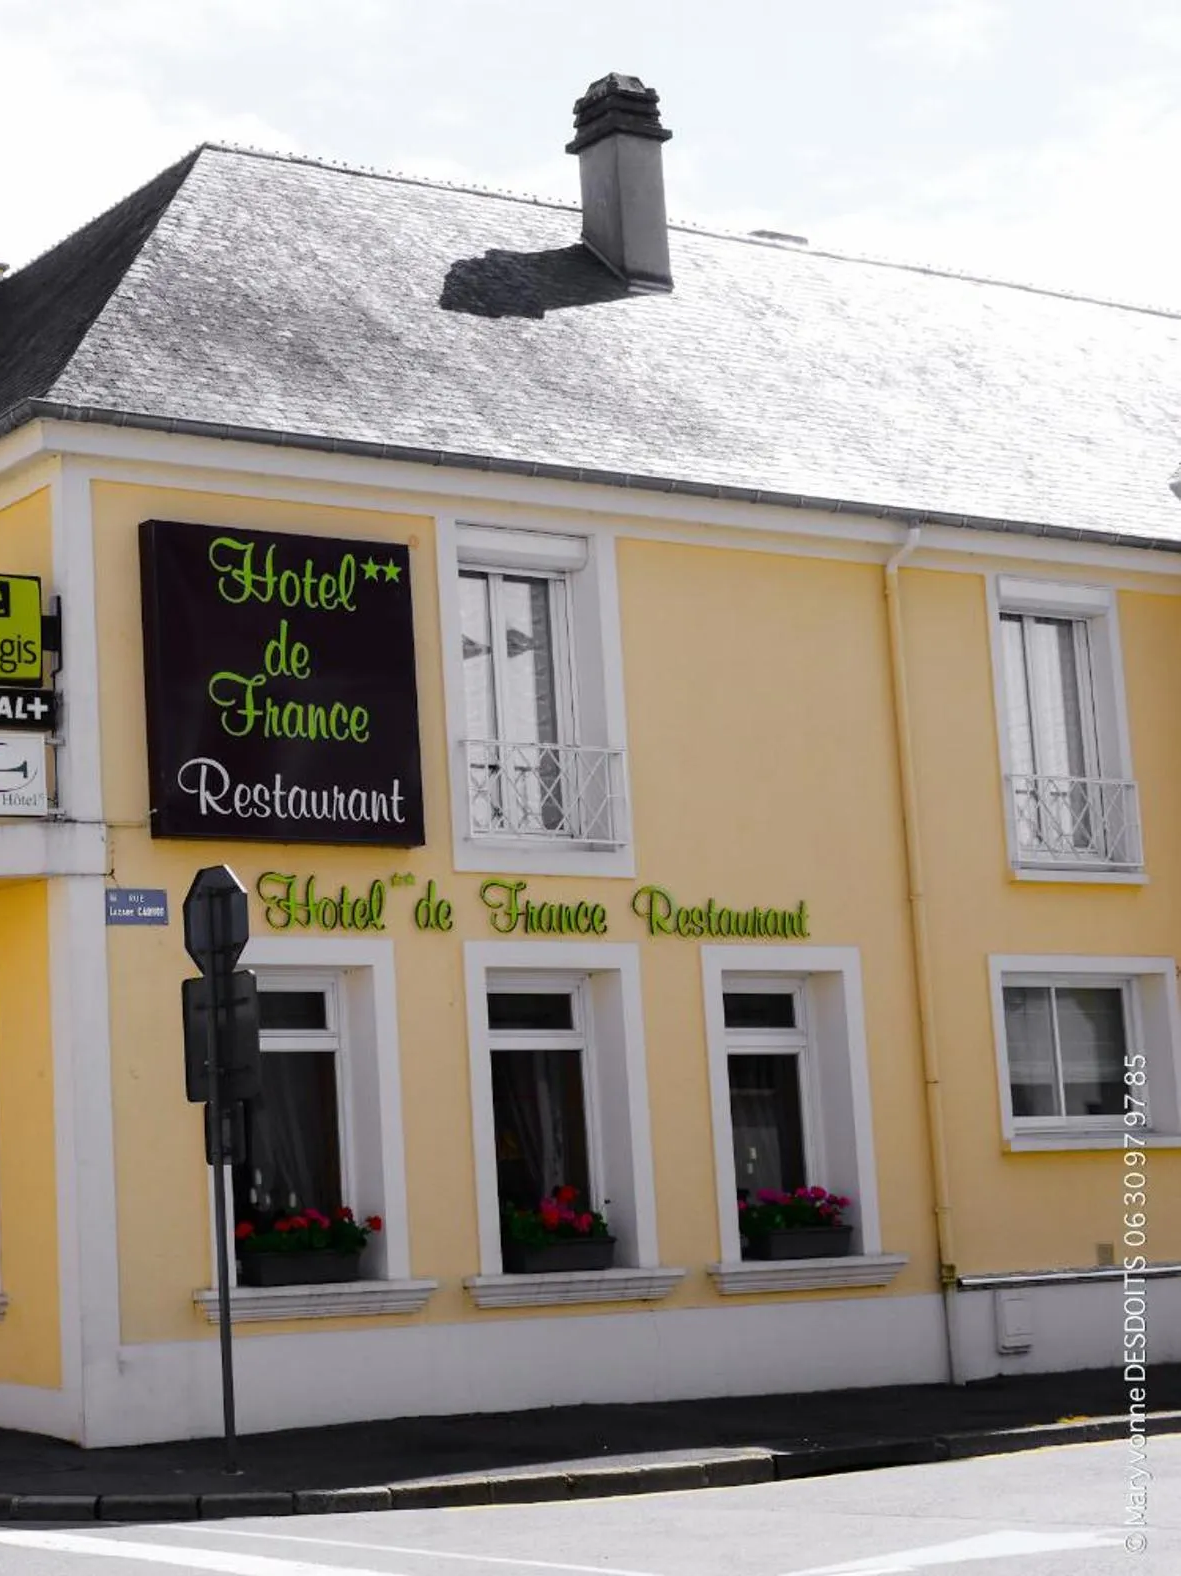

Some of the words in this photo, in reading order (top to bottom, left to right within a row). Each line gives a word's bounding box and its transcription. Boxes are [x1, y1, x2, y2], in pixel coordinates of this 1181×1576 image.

[208, 537, 357, 612] Hotel
[264, 619, 310, 680] de
[208, 671, 370, 743] France
[178, 757, 406, 824] Restaurant
[257, 871, 385, 931] Hotel
[415, 879, 453, 931] de
[480, 877, 608, 934] France
[632, 885, 811, 938] Restaurant
